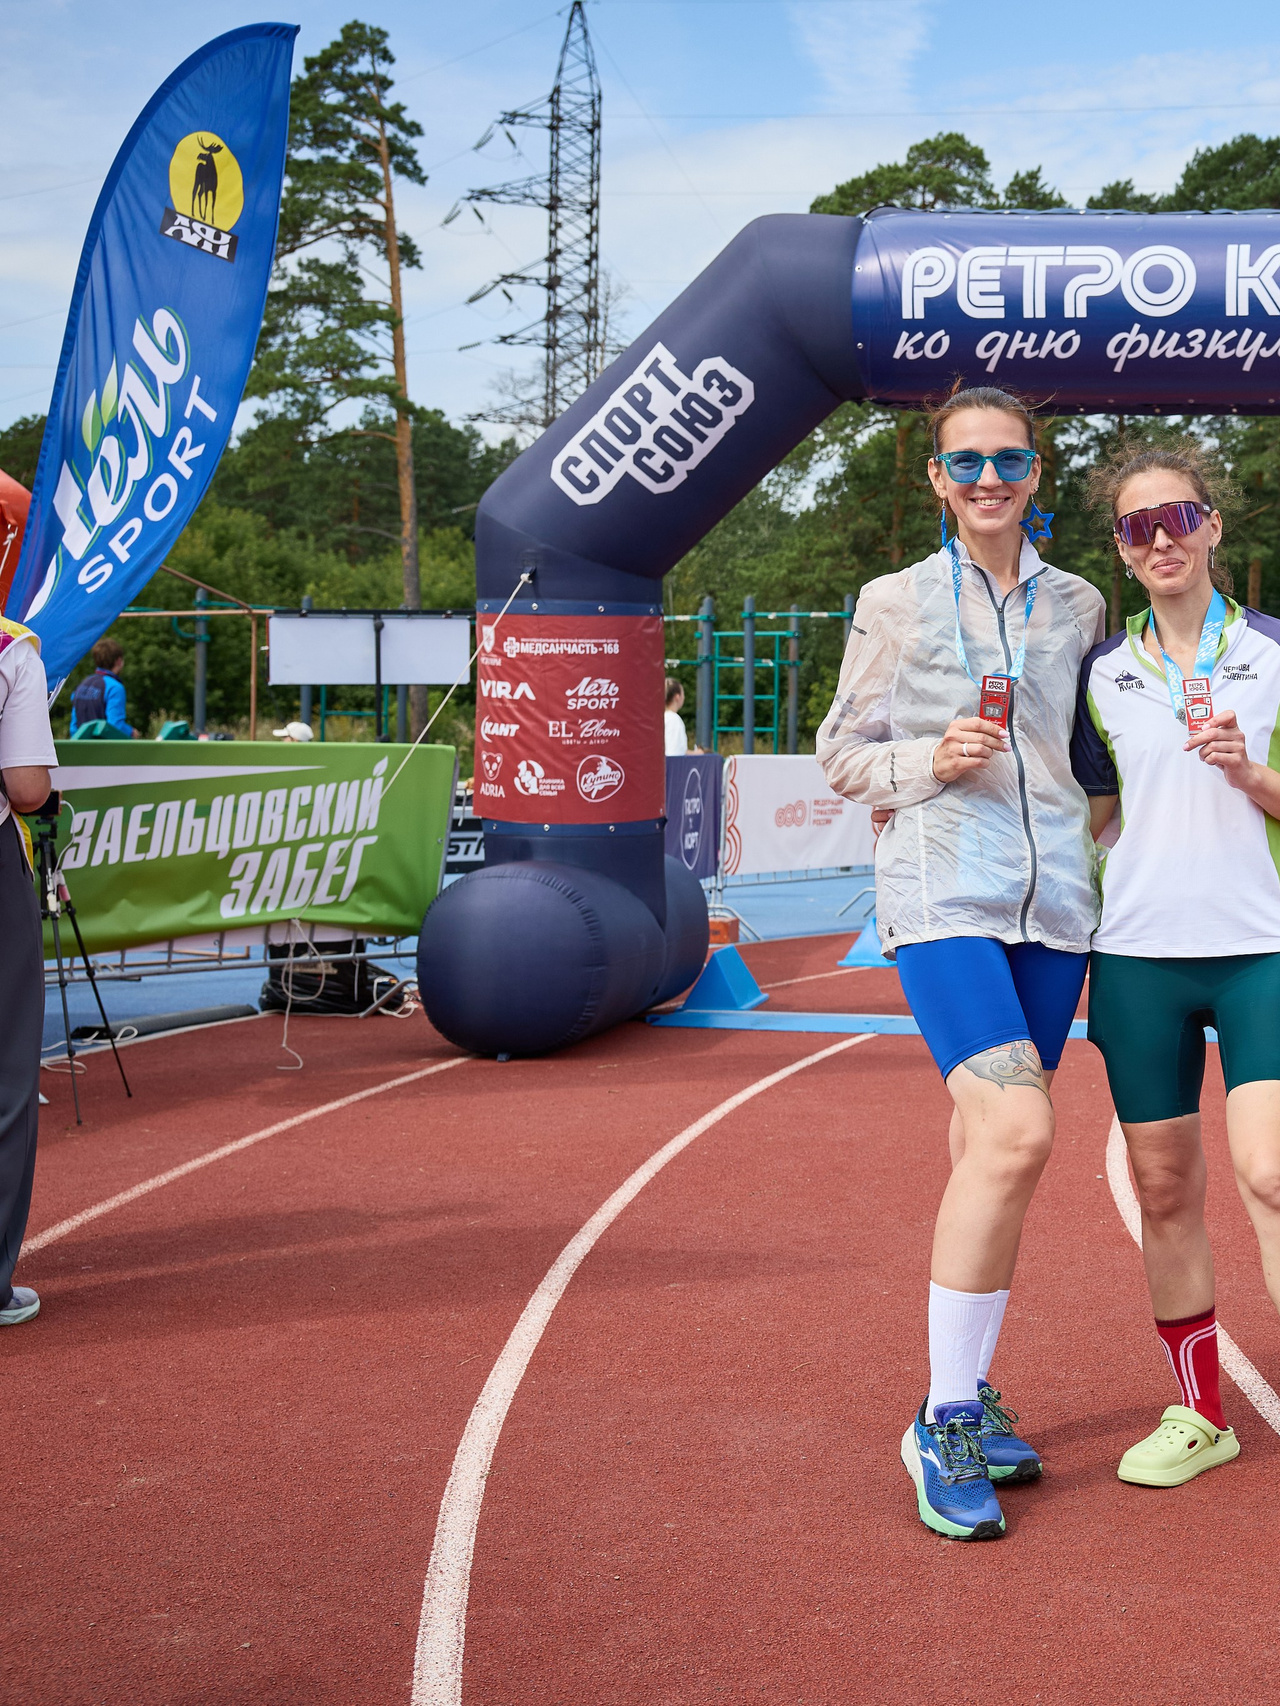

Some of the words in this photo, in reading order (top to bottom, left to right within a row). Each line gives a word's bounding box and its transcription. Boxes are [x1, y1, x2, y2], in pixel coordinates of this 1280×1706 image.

[900, 244, 1197, 319] РЕТРО
[893, 325, 951, 361] ко
[975, 323, 1081, 374] дню
[560, 357, 682, 494] СПОРТ
[633, 369, 742, 484] СОЮЗ
[78, 374, 218, 594] SPORT
[480, 678, 536, 700] VIRA
[567, 697, 620, 710] SPORT
[548, 721, 574, 738] EL
[62, 757, 388, 871] ЗАЕЛЬЦОВСКИЙ
[480, 782, 506, 798] ADRIA
[219, 835, 379, 920] ЗАБЕГ
